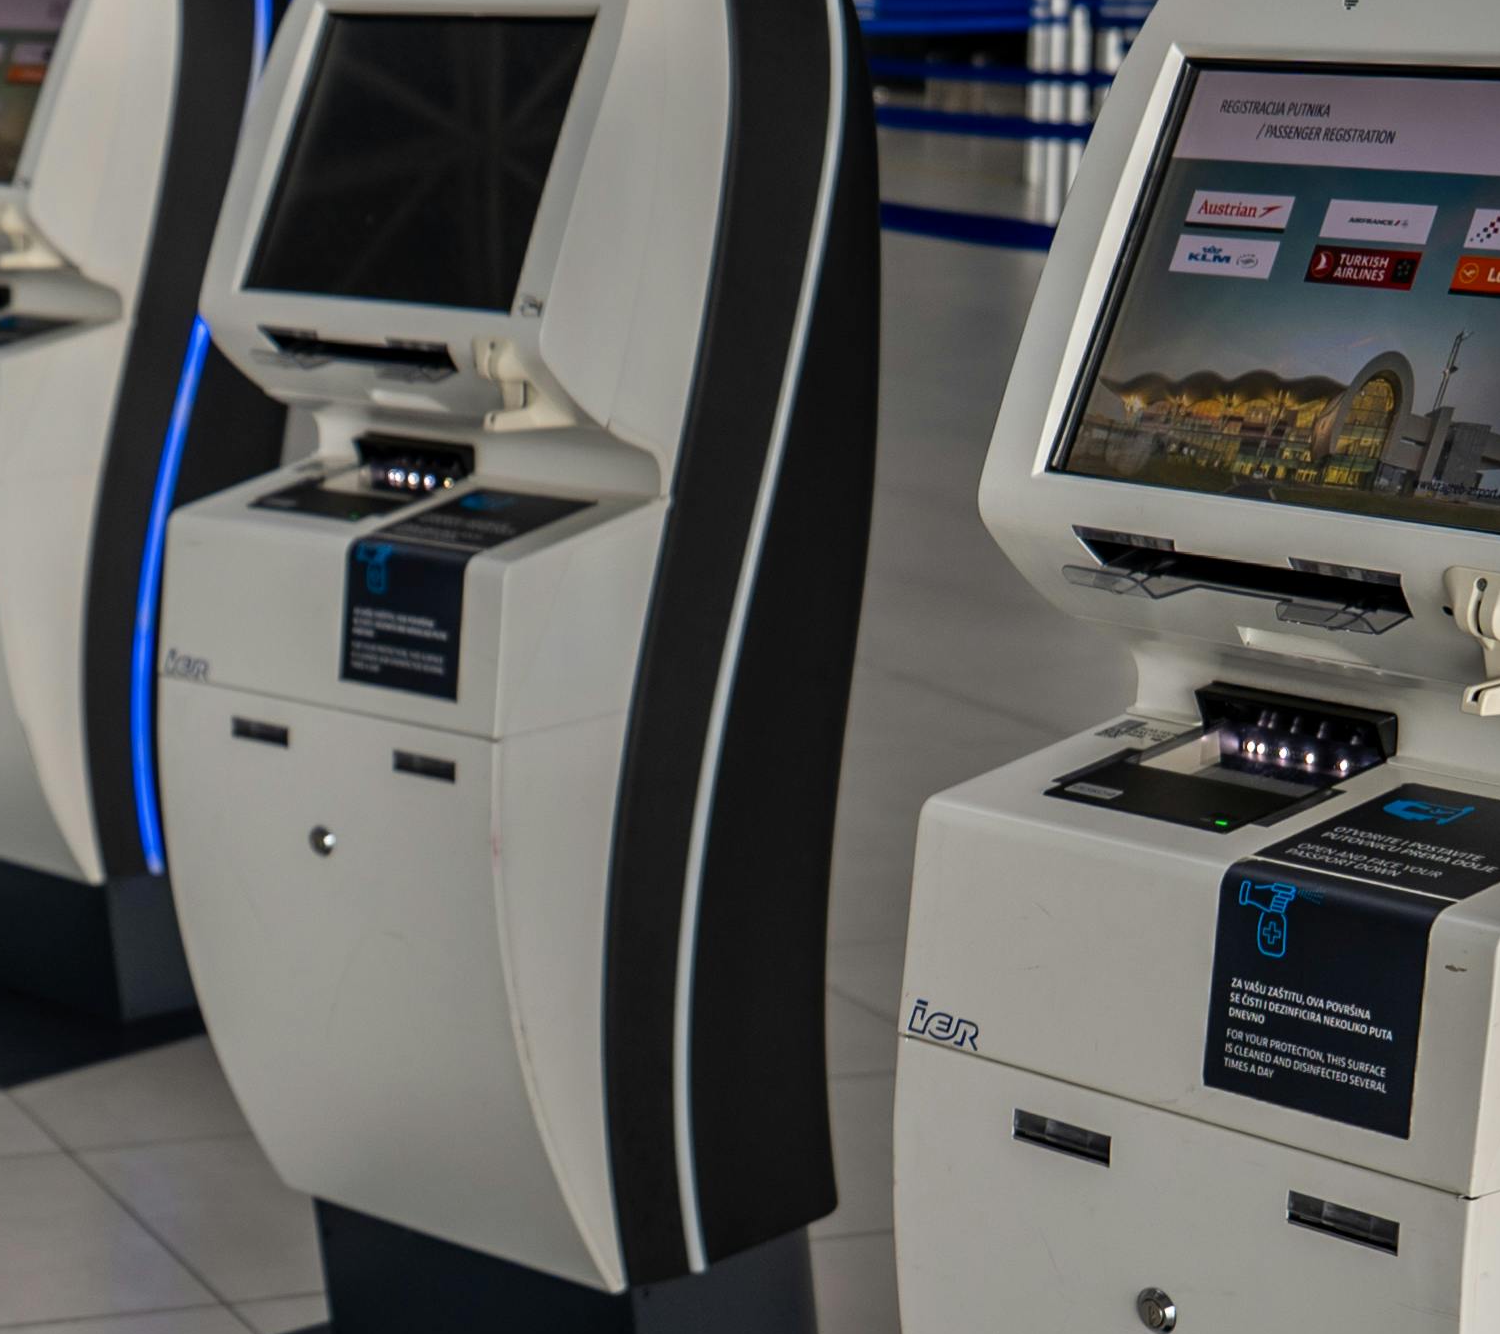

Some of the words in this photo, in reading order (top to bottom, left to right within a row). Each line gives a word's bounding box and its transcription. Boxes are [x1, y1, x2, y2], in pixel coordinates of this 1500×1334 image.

[1220, 99, 1285, 116] REGISTRACIJA
[1286, 102, 1331, 118] PUTNIKA
[1265, 124, 1322, 141] PASSENGER
[1322, 128, 1396, 144] REGISTRATION
[1198, 199, 1257, 218] Austrian
[1187, 252, 1231, 264] KLM
[1339, 253, 1389, 268] TURKISH
[1333, 267, 1385, 282] AIRLINES
[1321, 831, 1400, 852] PUTOVNICU
[1399, 848, 1450, 863] PREMA
[1451, 857, 1499, 874] DOLJE
[1333, 826, 1401, 844] OTVORITE
[1408, 841, 1485, 862] POSTAVITE
[1285, 847, 1354, 867] PASSPORT
[1354, 863, 1401, 877] DOWN
[1297, 842, 1335, 855] OPEN
[1336, 850, 1367, 861] AND
[1367, 856, 1403, 869] FACE
[1404, 865, 1444, 879] YOUR
[1231, 977, 1242, 989] ZA
[1244, 980, 1266, 995] VAŠU
[1267, 984, 1305, 1005] ZAŠTITU,
[1306, 995, 1324, 1009] OVA
[1326, 1000, 1371, 1020] POVRŠINA
[1228, 1007, 1265, 1024] DNEVNO
[1230, 992, 1240, 1004] SE
[1241, 993, 1263, 1009] ČISTI
[1268, 1001, 1322, 1024] DEZINFICIRA
[1322, 1016, 1368, 1035] NEKOLIKO
[1368, 1025, 1393, 1041] PUTA
[1226, 1028, 1244, 1042] FOR
[1245, 1032, 1268, 1047] YOUR
[1269, 1038, 1325, 1063] PROTECTION,
[1326, 1054, 1346, 1067] THIS
[1347, 1058, 1387, 1078] SURFACE
[1224, 1042, 1233, 1054] IS
[1234, 1045, 1272, 1063] CLEANED
[1273, 1055, 1292, 1068] AND
[1293, 1059, 1348, 1083] DISINFECTED
[1349, 1074, 1387, 1094] SEVERAL
[1224, 1057, 1248, 1072] TIMES
[1249, 1062, 1256, 1074] A
[1257, 1065, 1274, 1079] DAY
